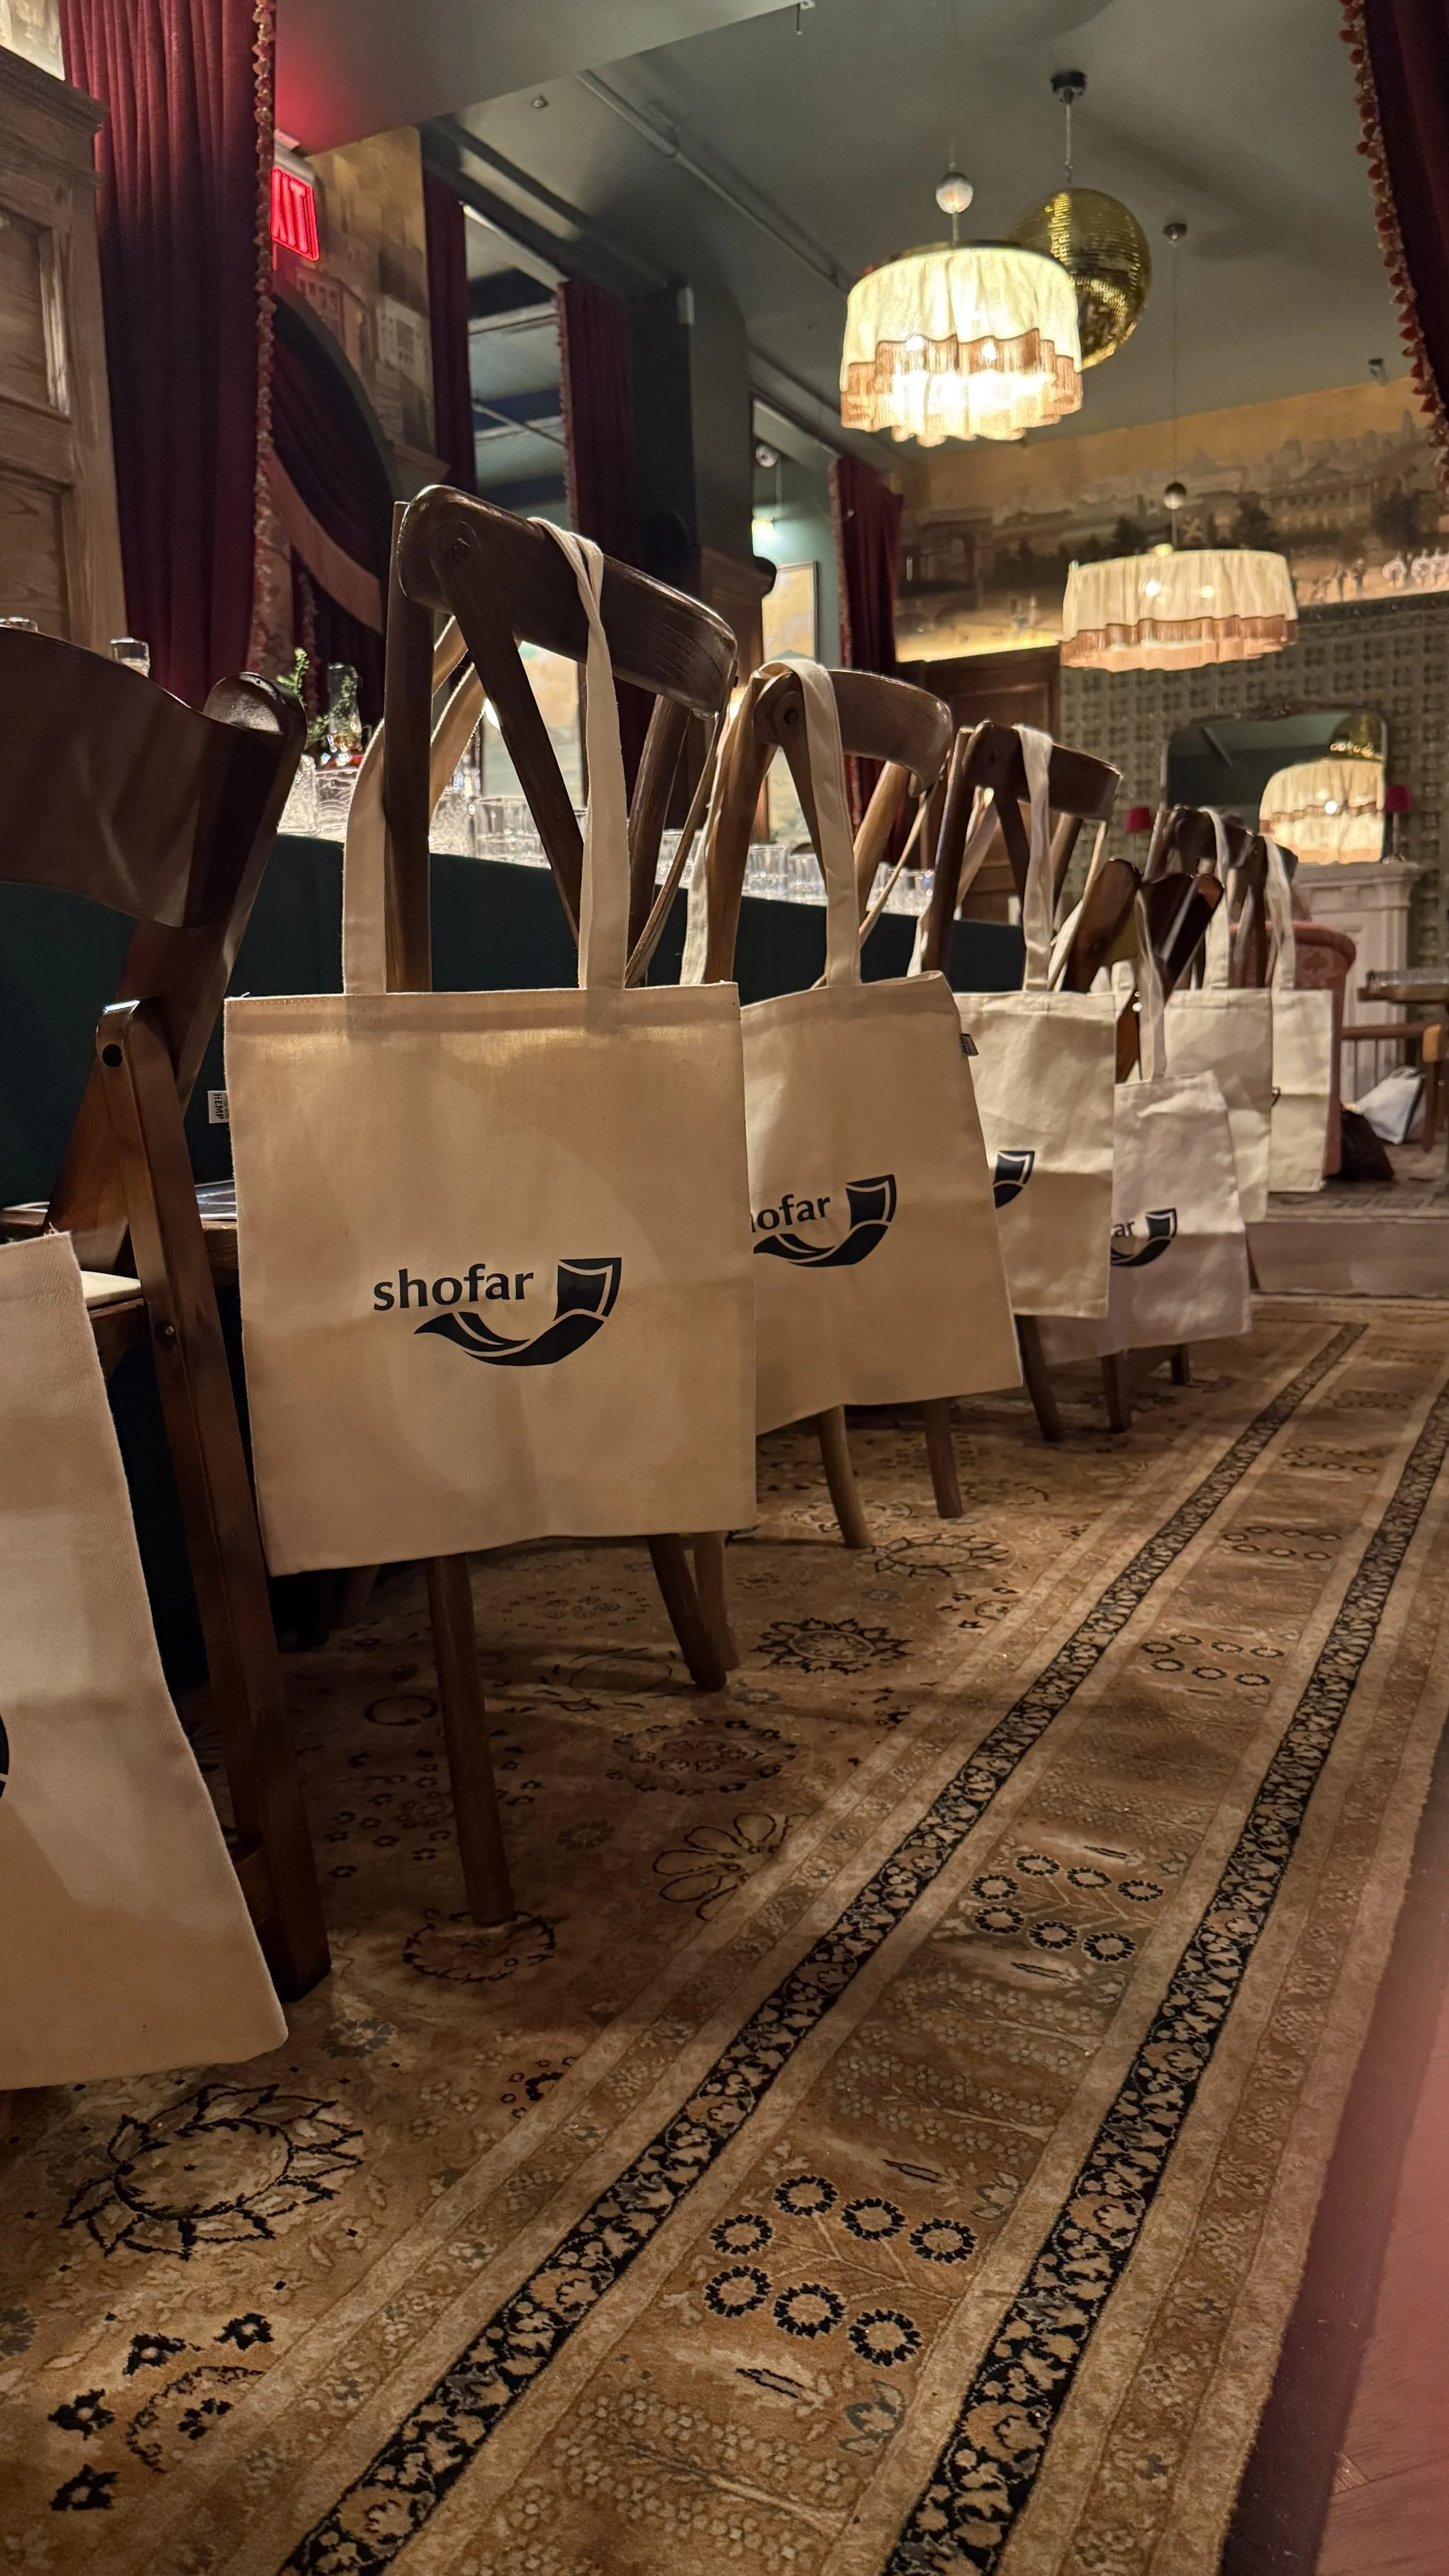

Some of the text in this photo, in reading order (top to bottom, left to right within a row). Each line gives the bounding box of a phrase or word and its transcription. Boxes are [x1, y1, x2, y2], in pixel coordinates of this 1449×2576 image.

[272, 170, 308, 253] XIT
[213, 1094, 224, 1119] HEMP
[1112, 1220, 1135, 1238] ar
[373, 1263, 534, 1311] shofar
